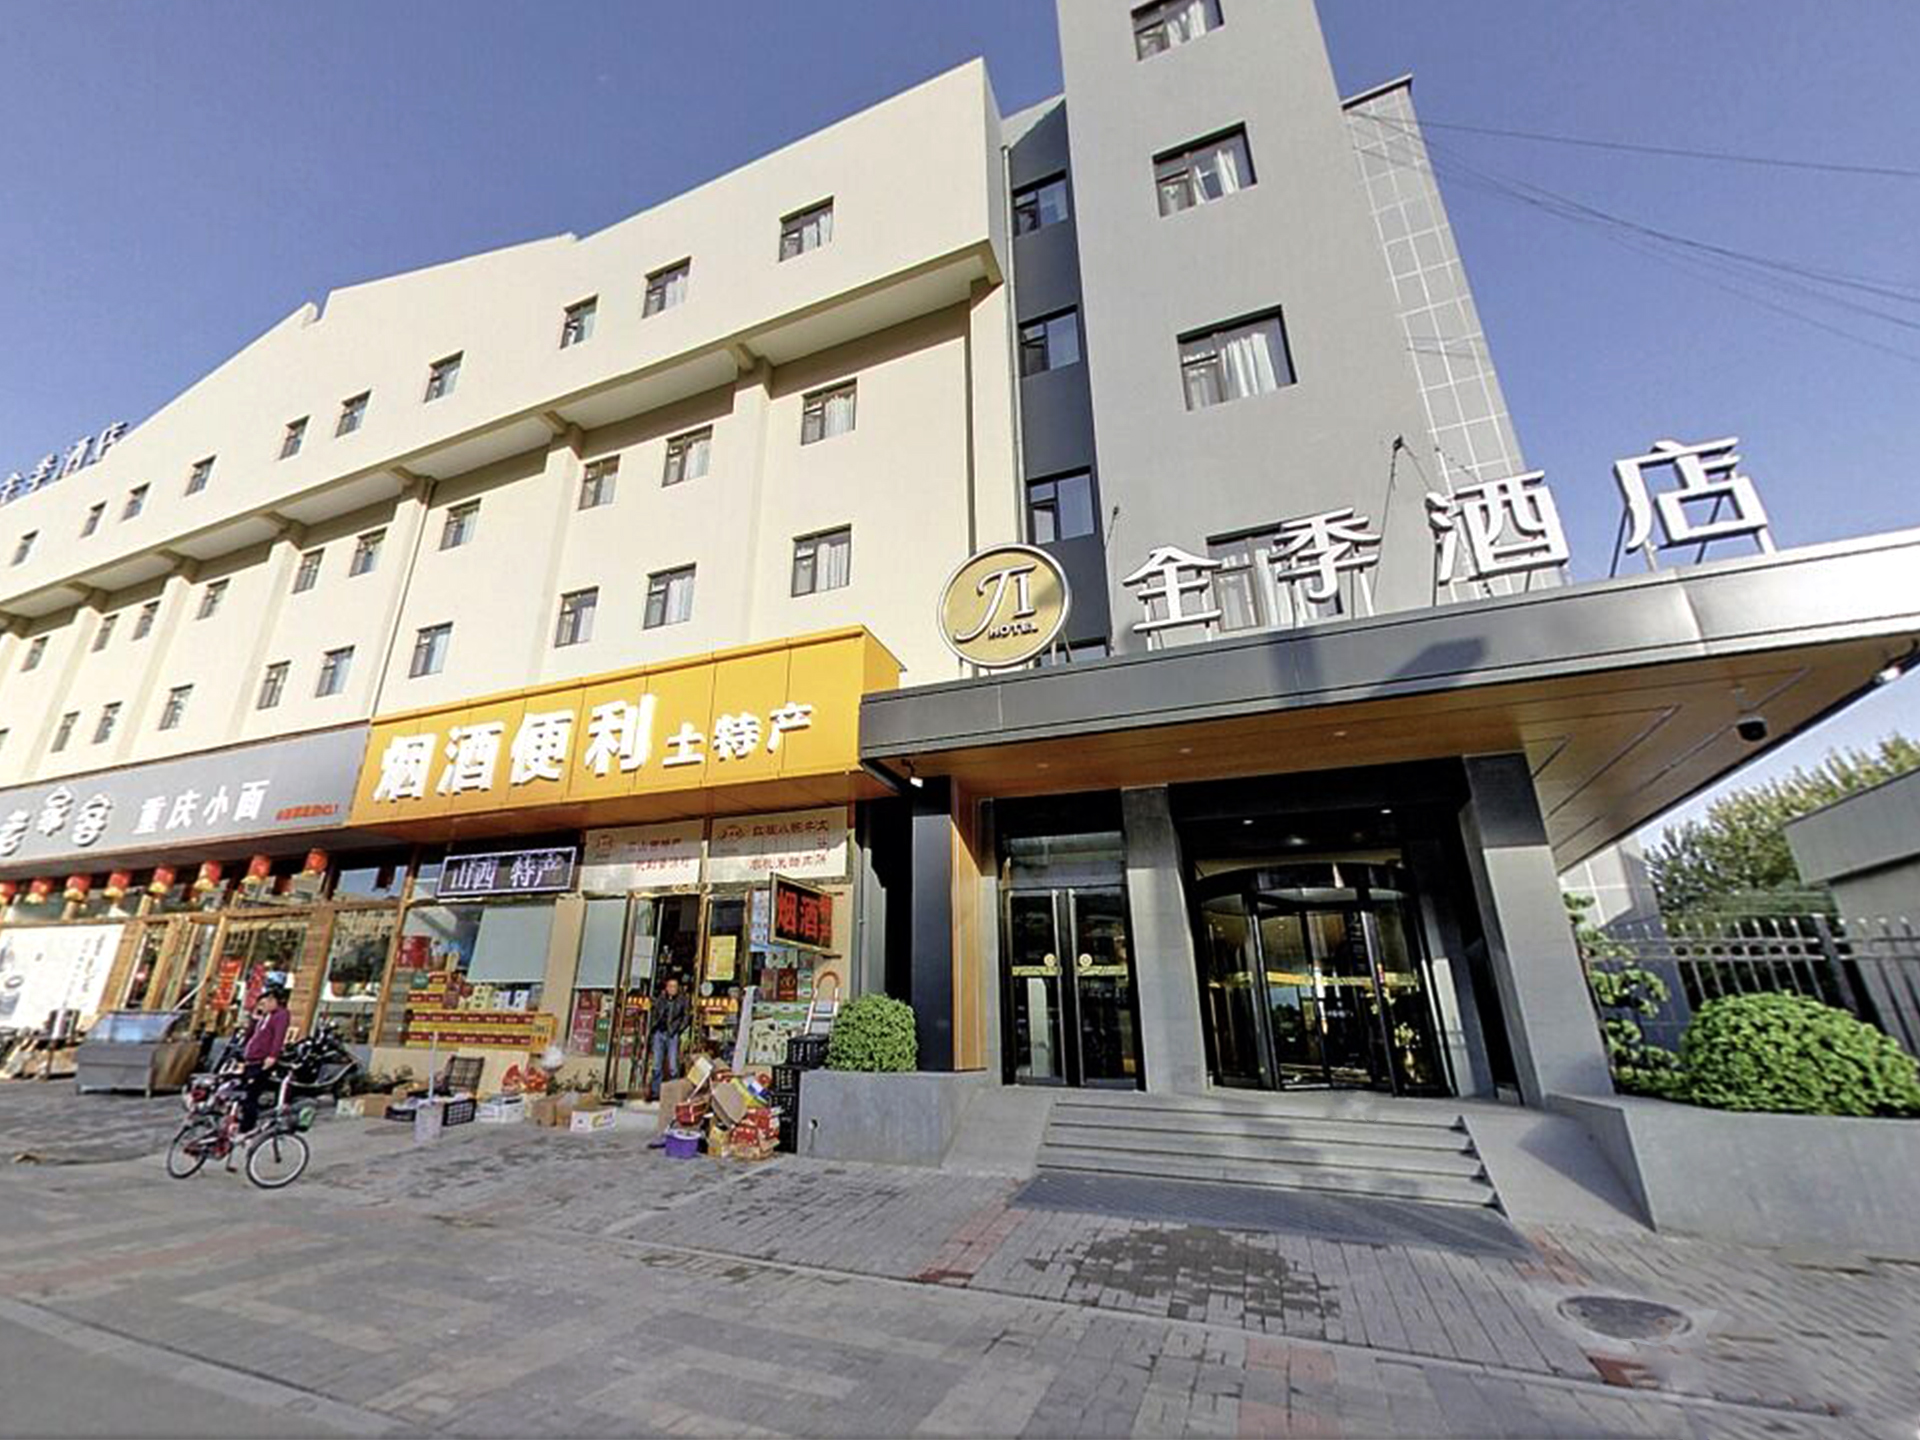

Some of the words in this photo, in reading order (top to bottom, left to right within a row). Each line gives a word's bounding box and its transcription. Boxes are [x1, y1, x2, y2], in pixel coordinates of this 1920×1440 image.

[1122, 437, 1768, 634] 全季酒店
[988, 620, 1039, 641] HOTEL
[374, 694, 656, 802] 烟酒便利
[663, 701, 812, 768] 土特产
[132, 779, 270, 834] 重庆小面
[451, 859, 498, 889] 山西
[510, 851, 564, 887] 特产
